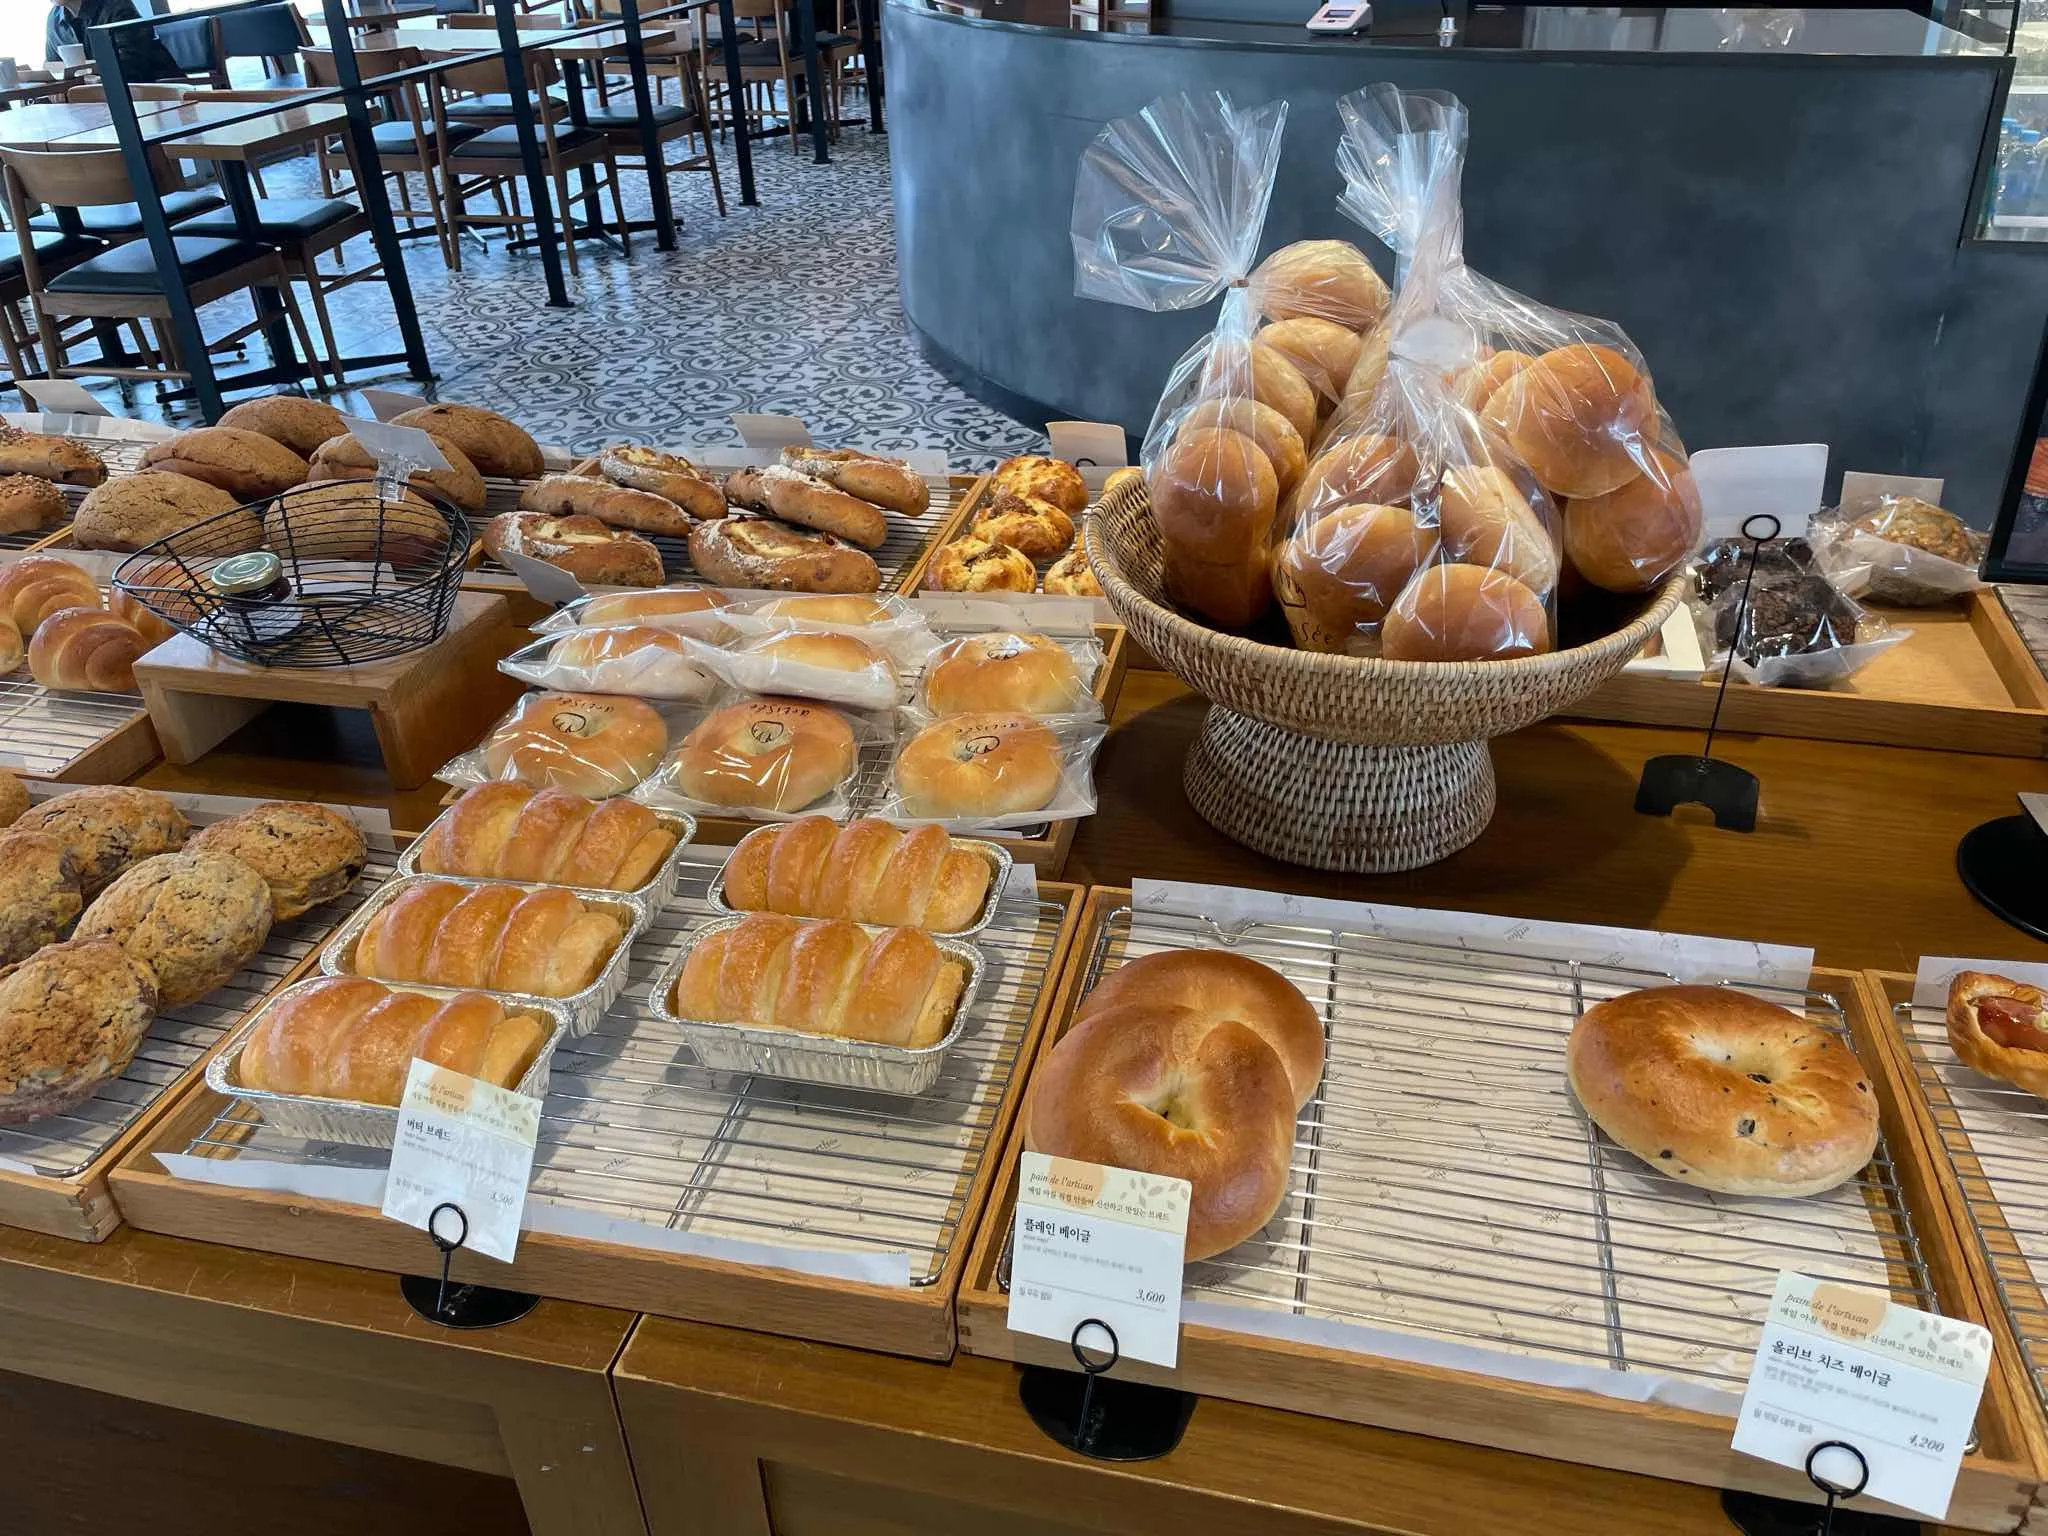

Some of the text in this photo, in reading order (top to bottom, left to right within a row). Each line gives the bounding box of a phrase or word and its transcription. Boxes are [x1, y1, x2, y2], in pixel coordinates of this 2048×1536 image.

[407, 1119, 424, 1133] 버터
[425, 1125, 452, 1142] 브레드
[1030, 1172, 1095, 1192] pain de l'artisan
[1024, 1217, 1056, 1237] 플레인
[1059, 1224, 1092, 1244] 베이글
[1136, 1288, 1166, 1304] 3,600
[1784, 1293, 1870, 1325] pain de l'artisan
[1771, 1340, 1813, 1362] 올리브
[1817, 1351, 1845, 1372] 치즈
[1849, 1363, 1893, 1388] 베이글
[1908, 1432, 1945, 1453] 4,200
